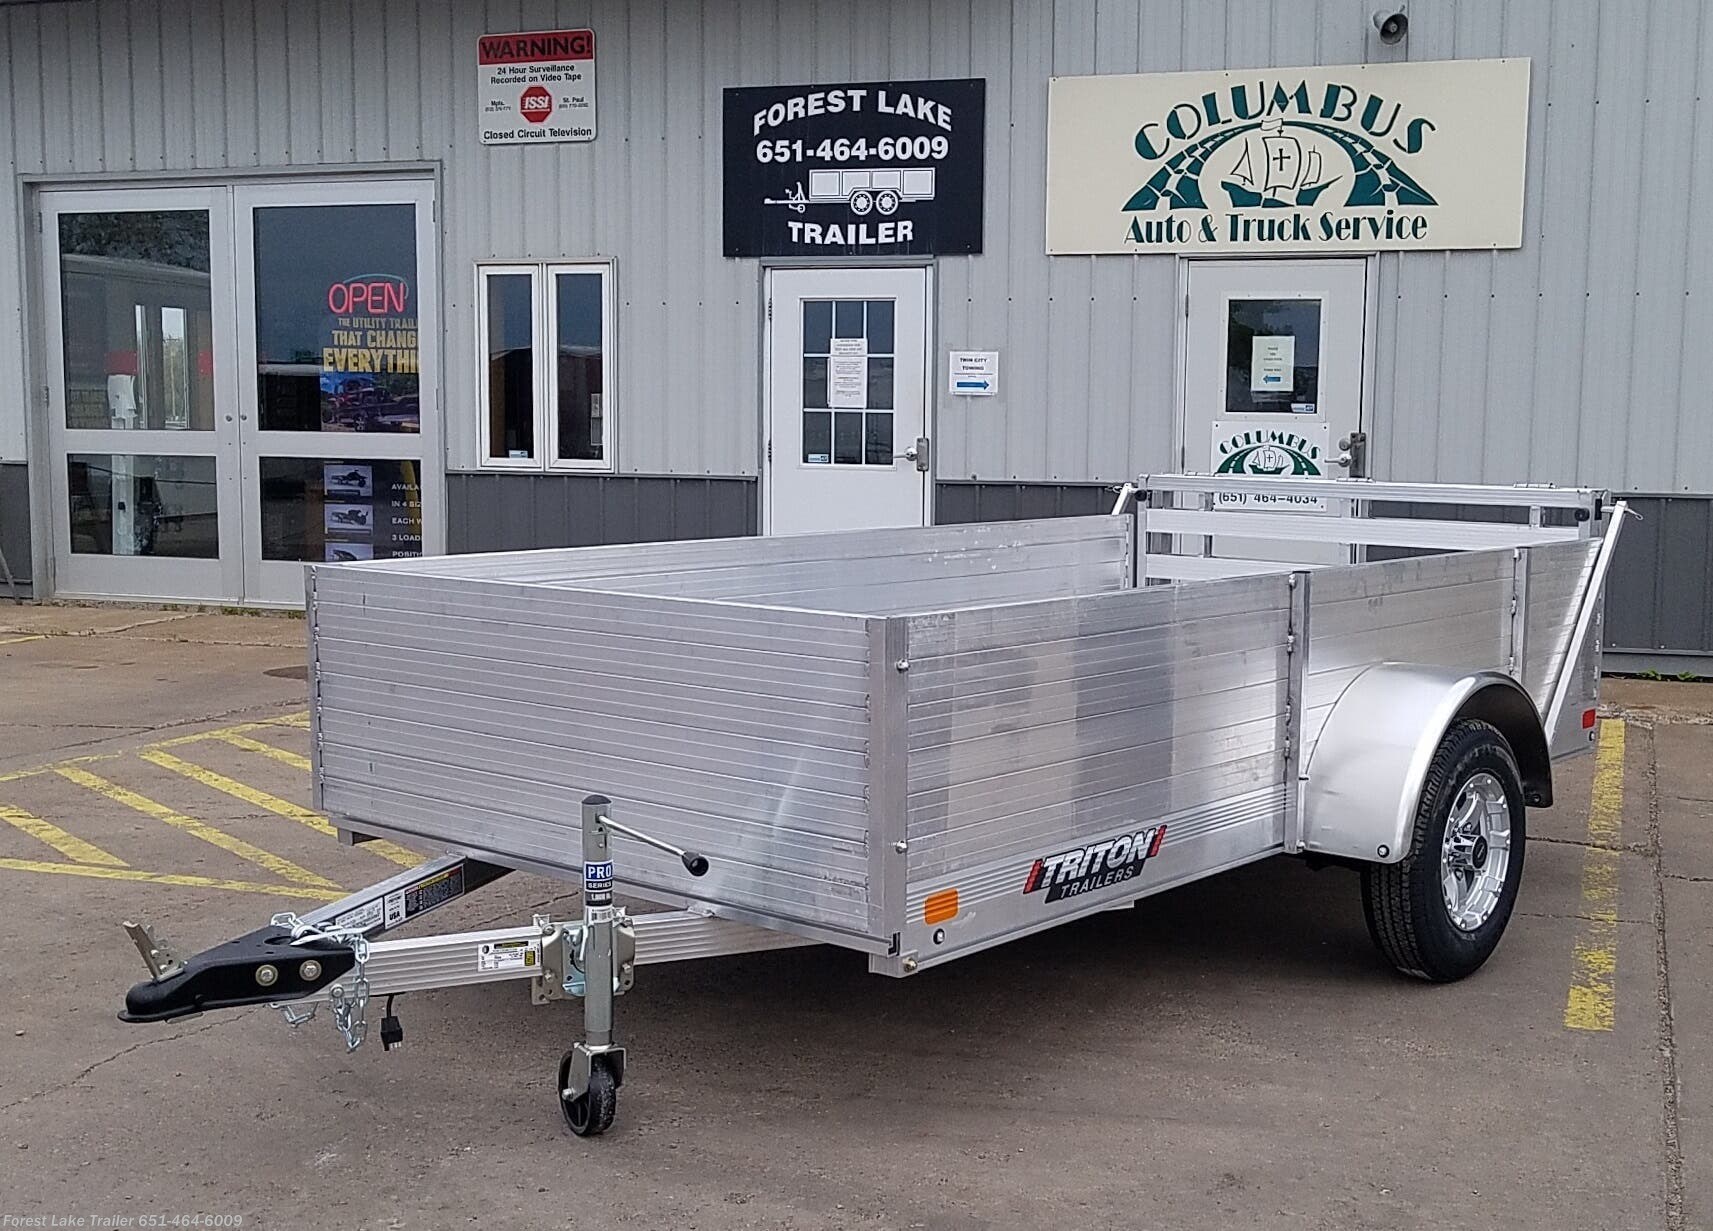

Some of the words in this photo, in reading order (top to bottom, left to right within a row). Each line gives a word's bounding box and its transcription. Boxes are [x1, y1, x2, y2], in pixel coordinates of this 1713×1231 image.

[482, 36, 592, 58] WARNING!
[491, 76, 526, 85] Recorded
[540, 74, 561, 82] Video
[564, 73, 582, 82] Tape
[509, 66, 527, 74] Hour
[529, 65, 575, 73] Surveillance
[754, 89, 867, 137] FOREST
[878, 90, 952, 132] LAKE
[1134, 80, 1436, 160] COLUMBUS
[484, 130, 514, 140] Closed
[517, 129, 546, 139] Circuit
[548, 127, 592, 138] Television
[756, 136, 949, 163] 651-464-6009
[787, 220, 914, 245] TRAILER
[1123, 214, 1191, 244] Auto
[1202, 216, 1219, 242] &
[1225, 212, 1311, 242] Truck
[1320, 209, 1428, 242] Service
[329, 283, 404, 312] OPEN
[338, 318, 351, 327] THE
[353, 317, 387, 329] UTILITY
[390, 318, 417, 329] TRAIL
[332, 330, 362, 346] THAT
[323, 348, 419, 373] EVERYTHI
[1220, 430, 1321, 459] COLUMBUS
[1219, 492, 1247, 505] (651)
[1040, 828, 1156, 888] TRITON
[587, 865, 612, 879] PRO
[1061, 865, 1135, 899] TRAILERS
